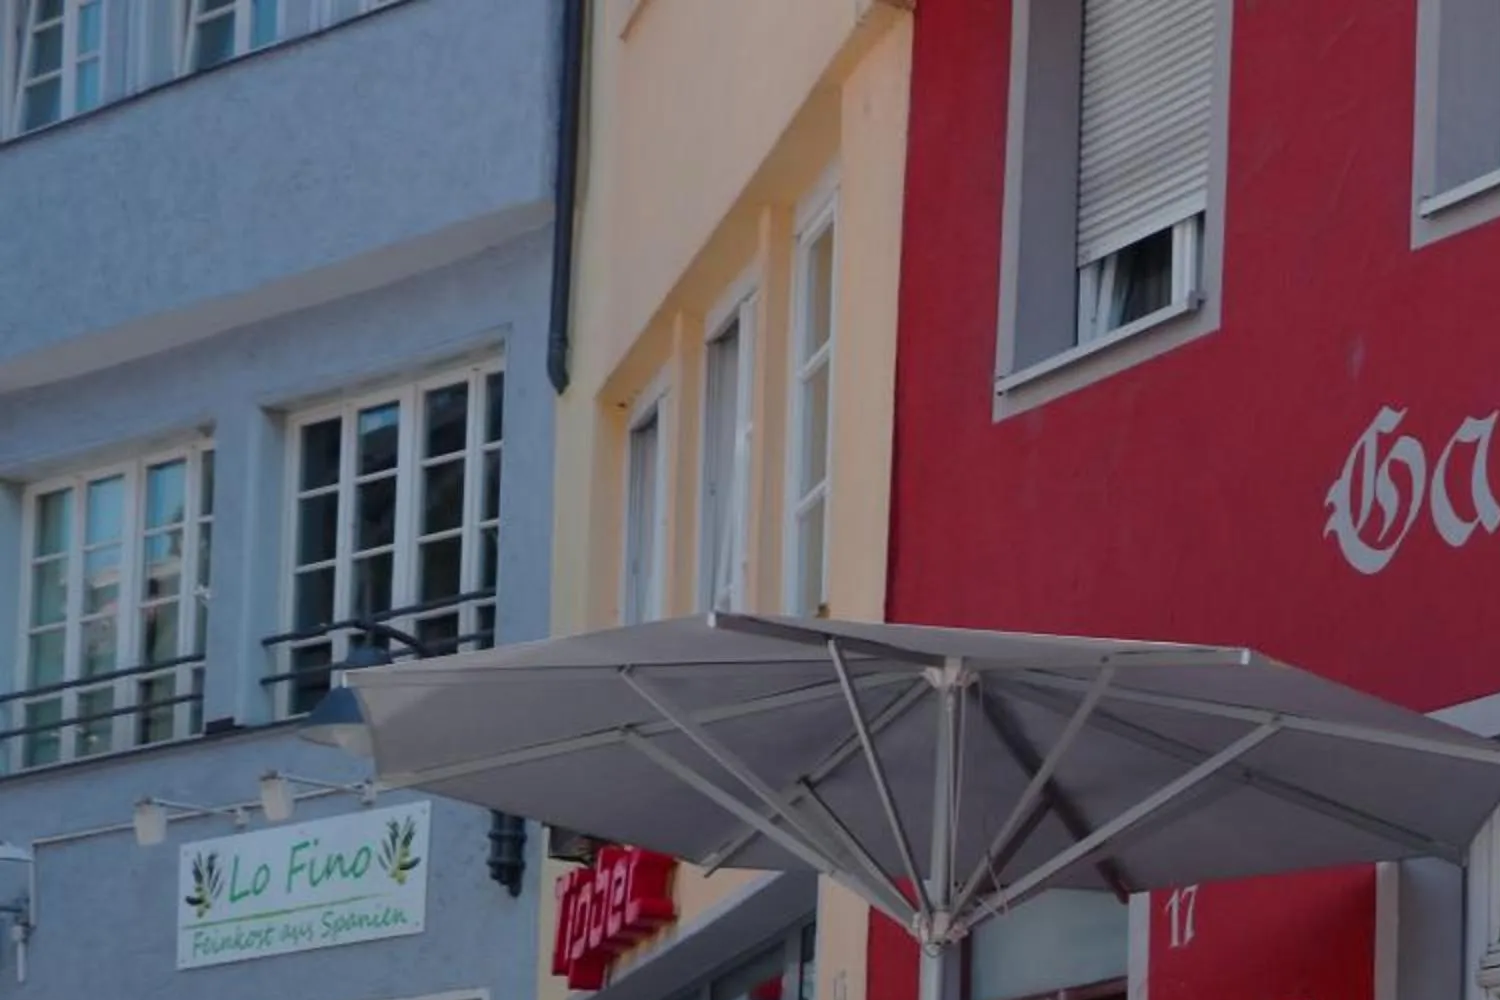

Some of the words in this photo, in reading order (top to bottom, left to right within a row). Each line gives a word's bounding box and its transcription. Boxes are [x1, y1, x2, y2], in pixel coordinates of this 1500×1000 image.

[229, 854, 271, 902] Lo
[286, 838, 373, 893] Fino
[192, 926, 275, 958] Feinkost
[280, 927, 314, 945] aus
[320, 907, 407, 942] Spanien
[1164, 884, 1199, 949] 17
